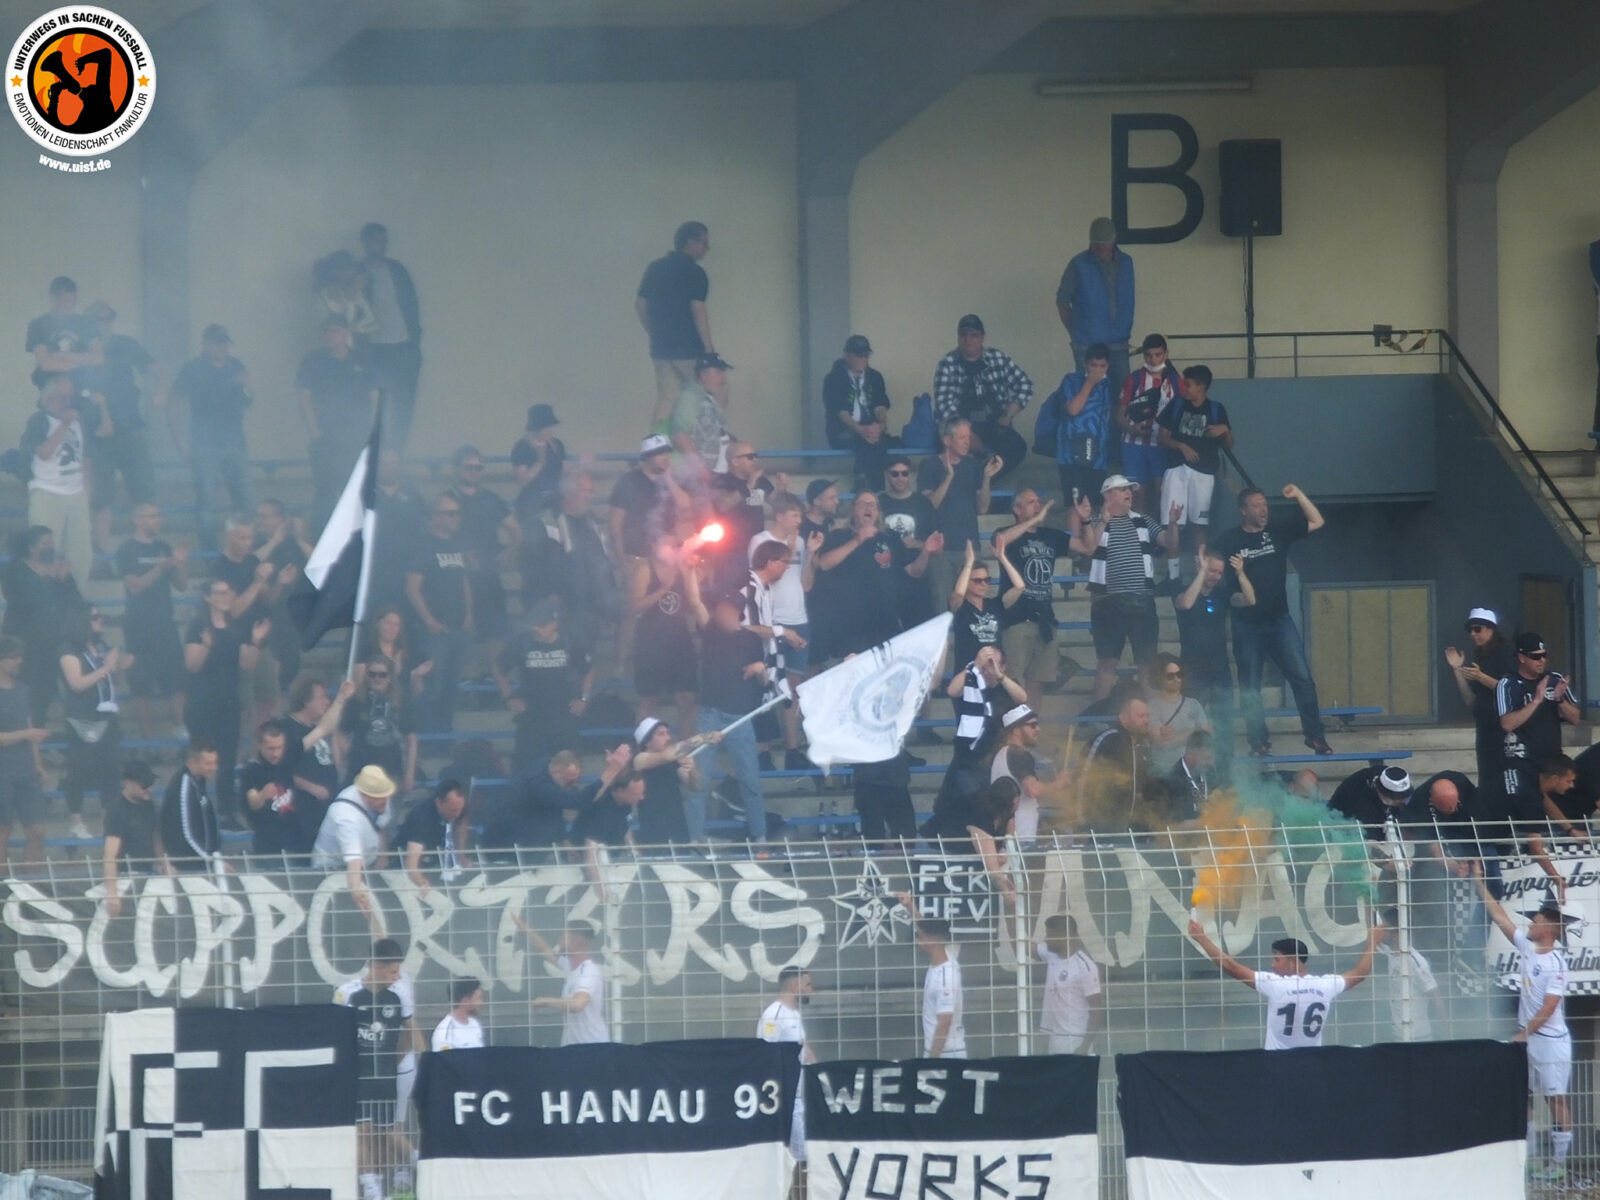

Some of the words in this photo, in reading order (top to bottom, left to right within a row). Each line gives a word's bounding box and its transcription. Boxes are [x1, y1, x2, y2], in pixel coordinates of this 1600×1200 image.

[1111, 113, 1204, 244] B
[919, 864, 989, 893] FCK
[1277, 1002, 1326, 1038] 16
[453, 1090, 511, 1126] FC
[541, 1088, 706, 1125] HANAU
[733, 1080, 781, 1120] 93
[817, 1066, 1000, 1115] WEST
[827, 1147, 1053, 1200] YORKS
